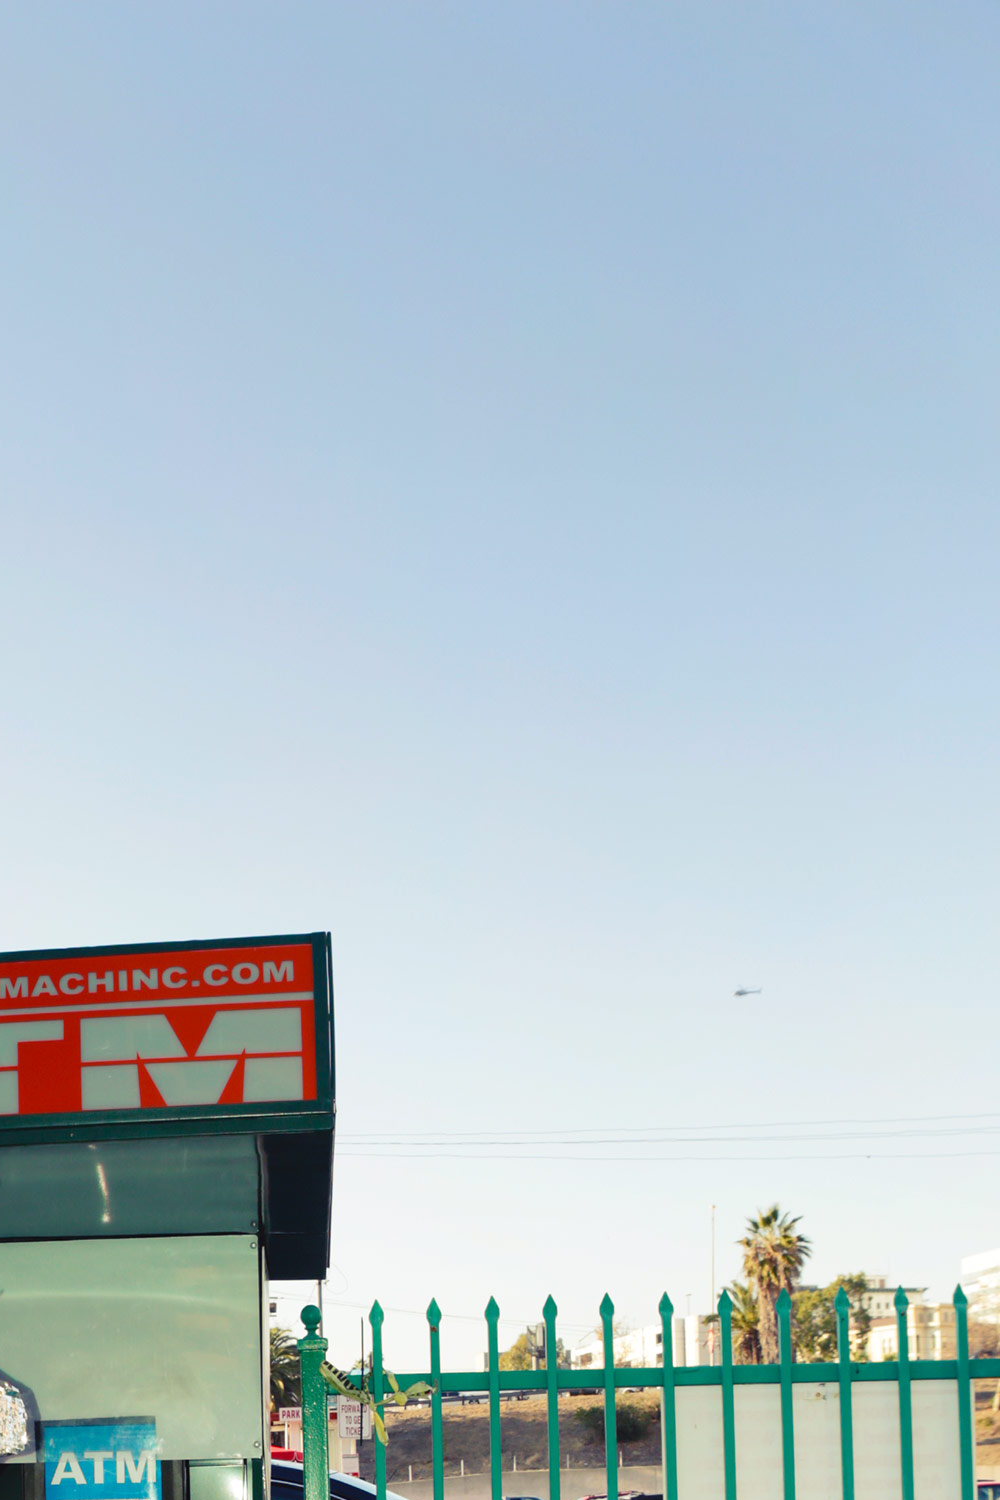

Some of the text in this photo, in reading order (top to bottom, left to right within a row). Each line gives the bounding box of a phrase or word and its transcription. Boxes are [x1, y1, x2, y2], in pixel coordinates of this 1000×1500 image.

[341, 1404, 367, 1413] FORWAD
[345, 1416, 364, 1425] TO GE
[345, 1427, 364, 1436] TICKE
[51, 1451, 157, 1485] ATM
